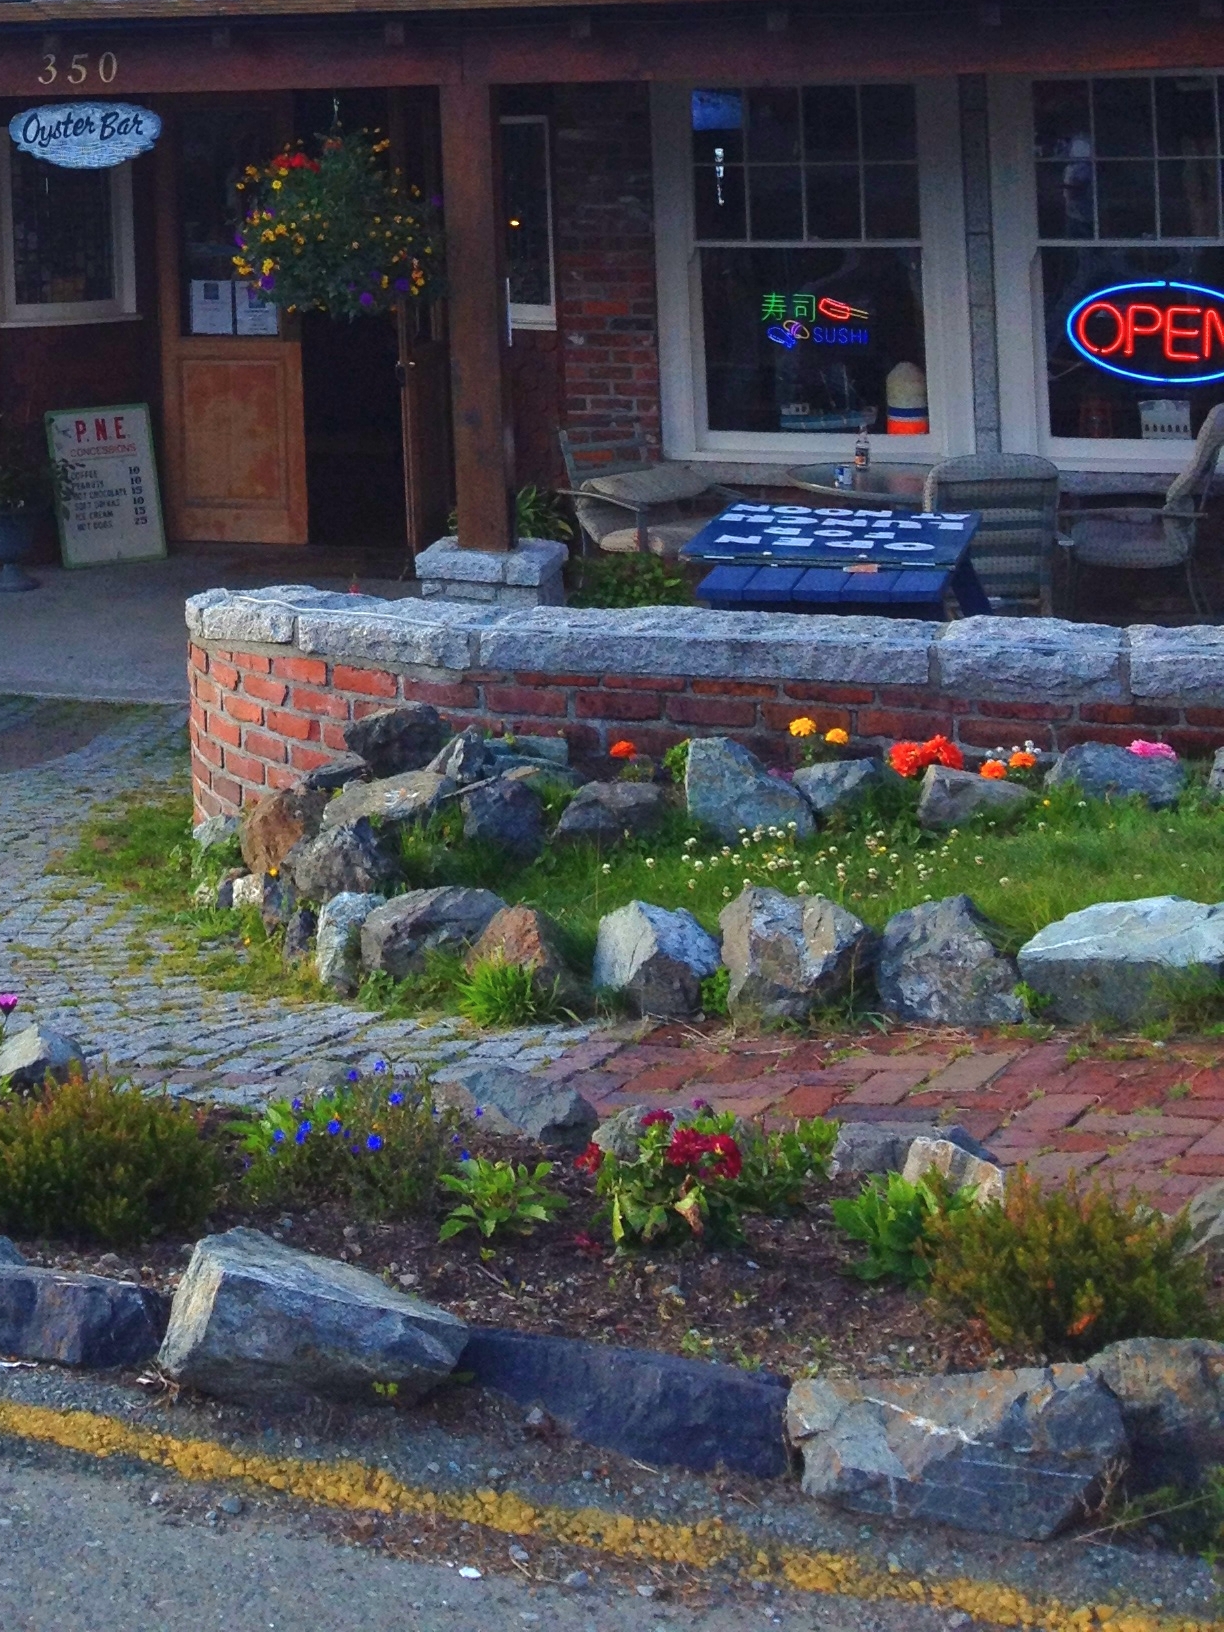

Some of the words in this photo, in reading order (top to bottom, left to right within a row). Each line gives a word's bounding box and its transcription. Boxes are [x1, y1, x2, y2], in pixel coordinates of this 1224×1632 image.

[37, 51, 119, 85] 350
[22, 111, 97, 148] Oyster
[99, 111, 144, 141] Bar
[761, 292, 816, 323] 寿司
[813, 326, 869, 344] SUSHI
[70, 443, 137, 458] CONCESSIONS
[71, 469, 98, 480] COFFEE
[128, 466, 141, 475] 10
[72, 480, 105, 490] PEANUTS
[130, 476, 142, 485] 10
[89, 488, 128, 500] CHOCOLATE
[131, 485, 143, 495] 15
[133, 496, 145, 505] 10
[89, 510, 114, 520] CREAM
[134, 506, 146, 515] 15
[730, 503, 893, 518] NOON
[911, 512, 972, 520] AT
[135, 516, 148, 525] 25
[719, 513, 965, 531] LUNCH
[763, 526, 897, 539] FOR
[714, 534, 936, 551] OPEN
